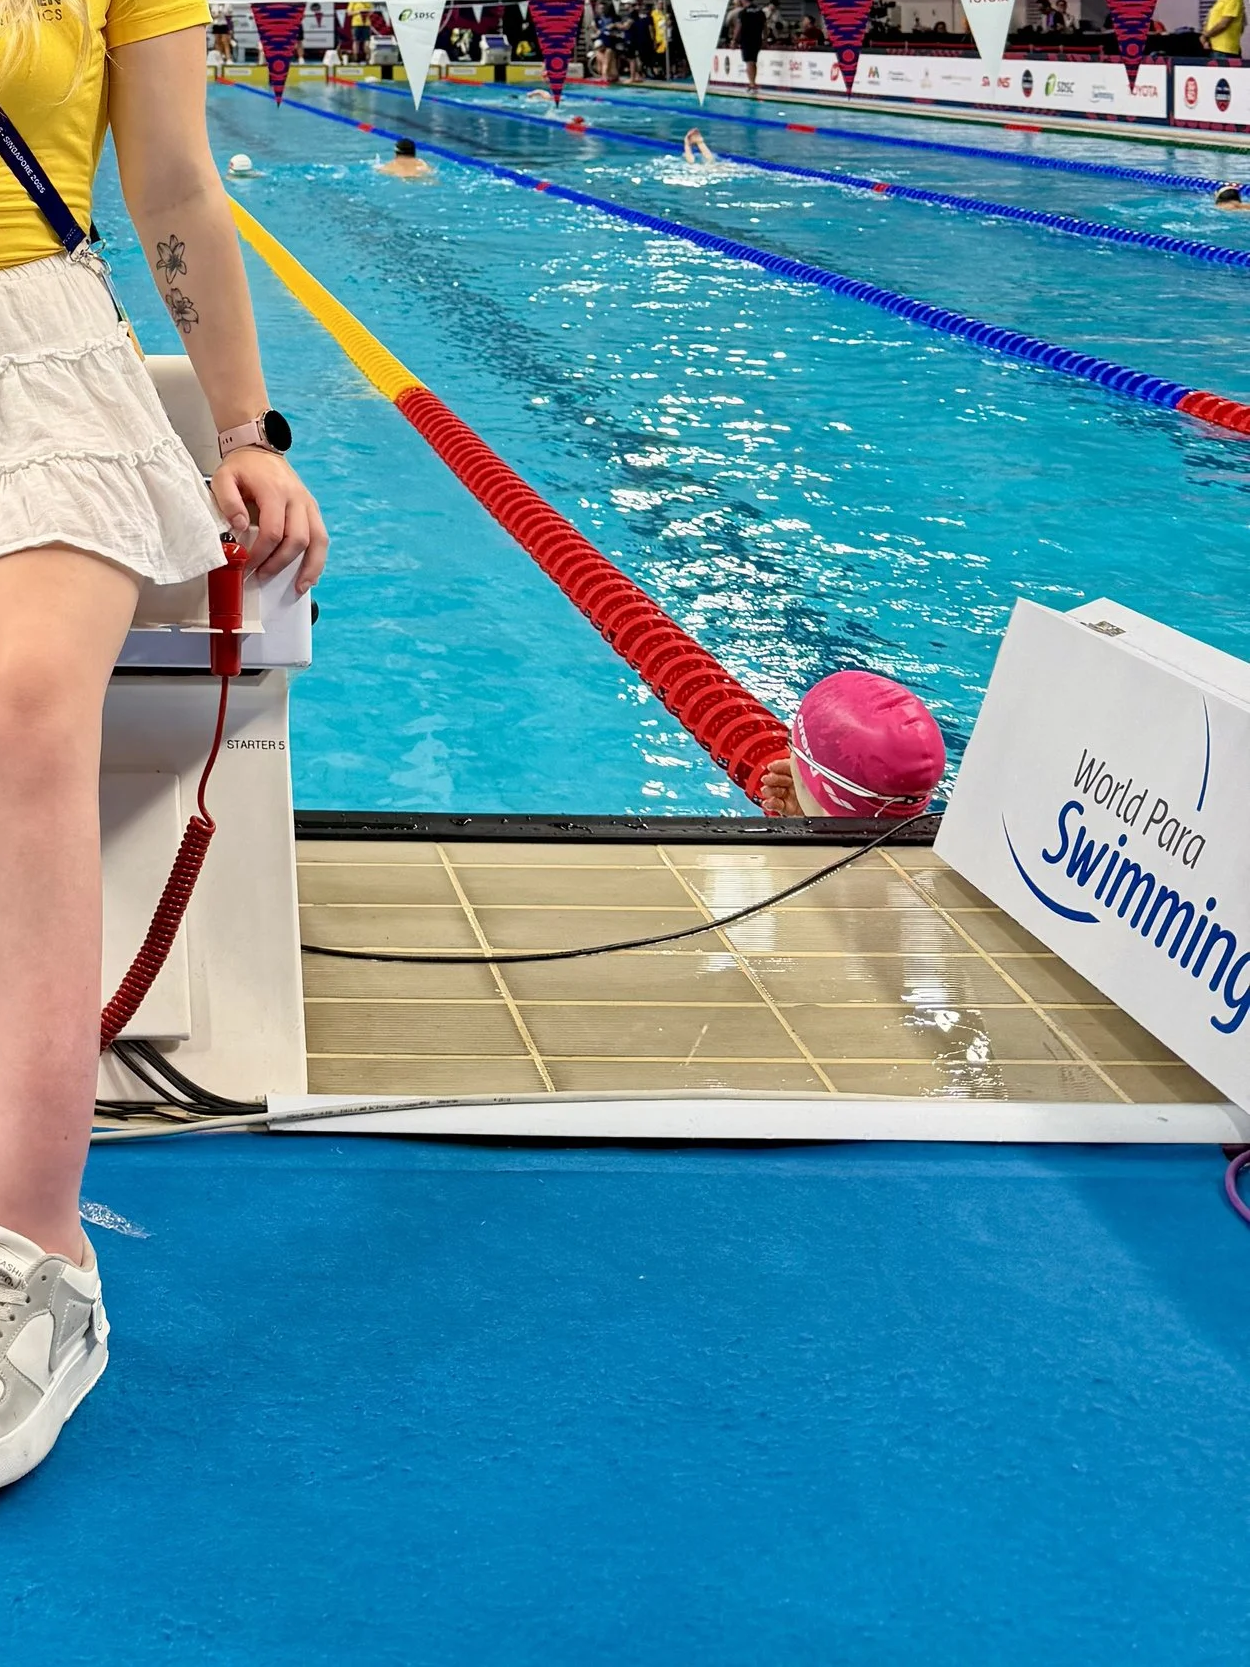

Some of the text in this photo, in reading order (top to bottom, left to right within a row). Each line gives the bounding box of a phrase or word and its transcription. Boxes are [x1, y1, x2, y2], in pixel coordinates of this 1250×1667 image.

[414, 12, 435, 20] SDSC
[3, 135, 34, 176] SINGAPORE
[227, 739, 285, 750] STARTER 5
[1073, 748, 1206, 869] World Para
[1041, 800, 1250, 1034] Swimming
